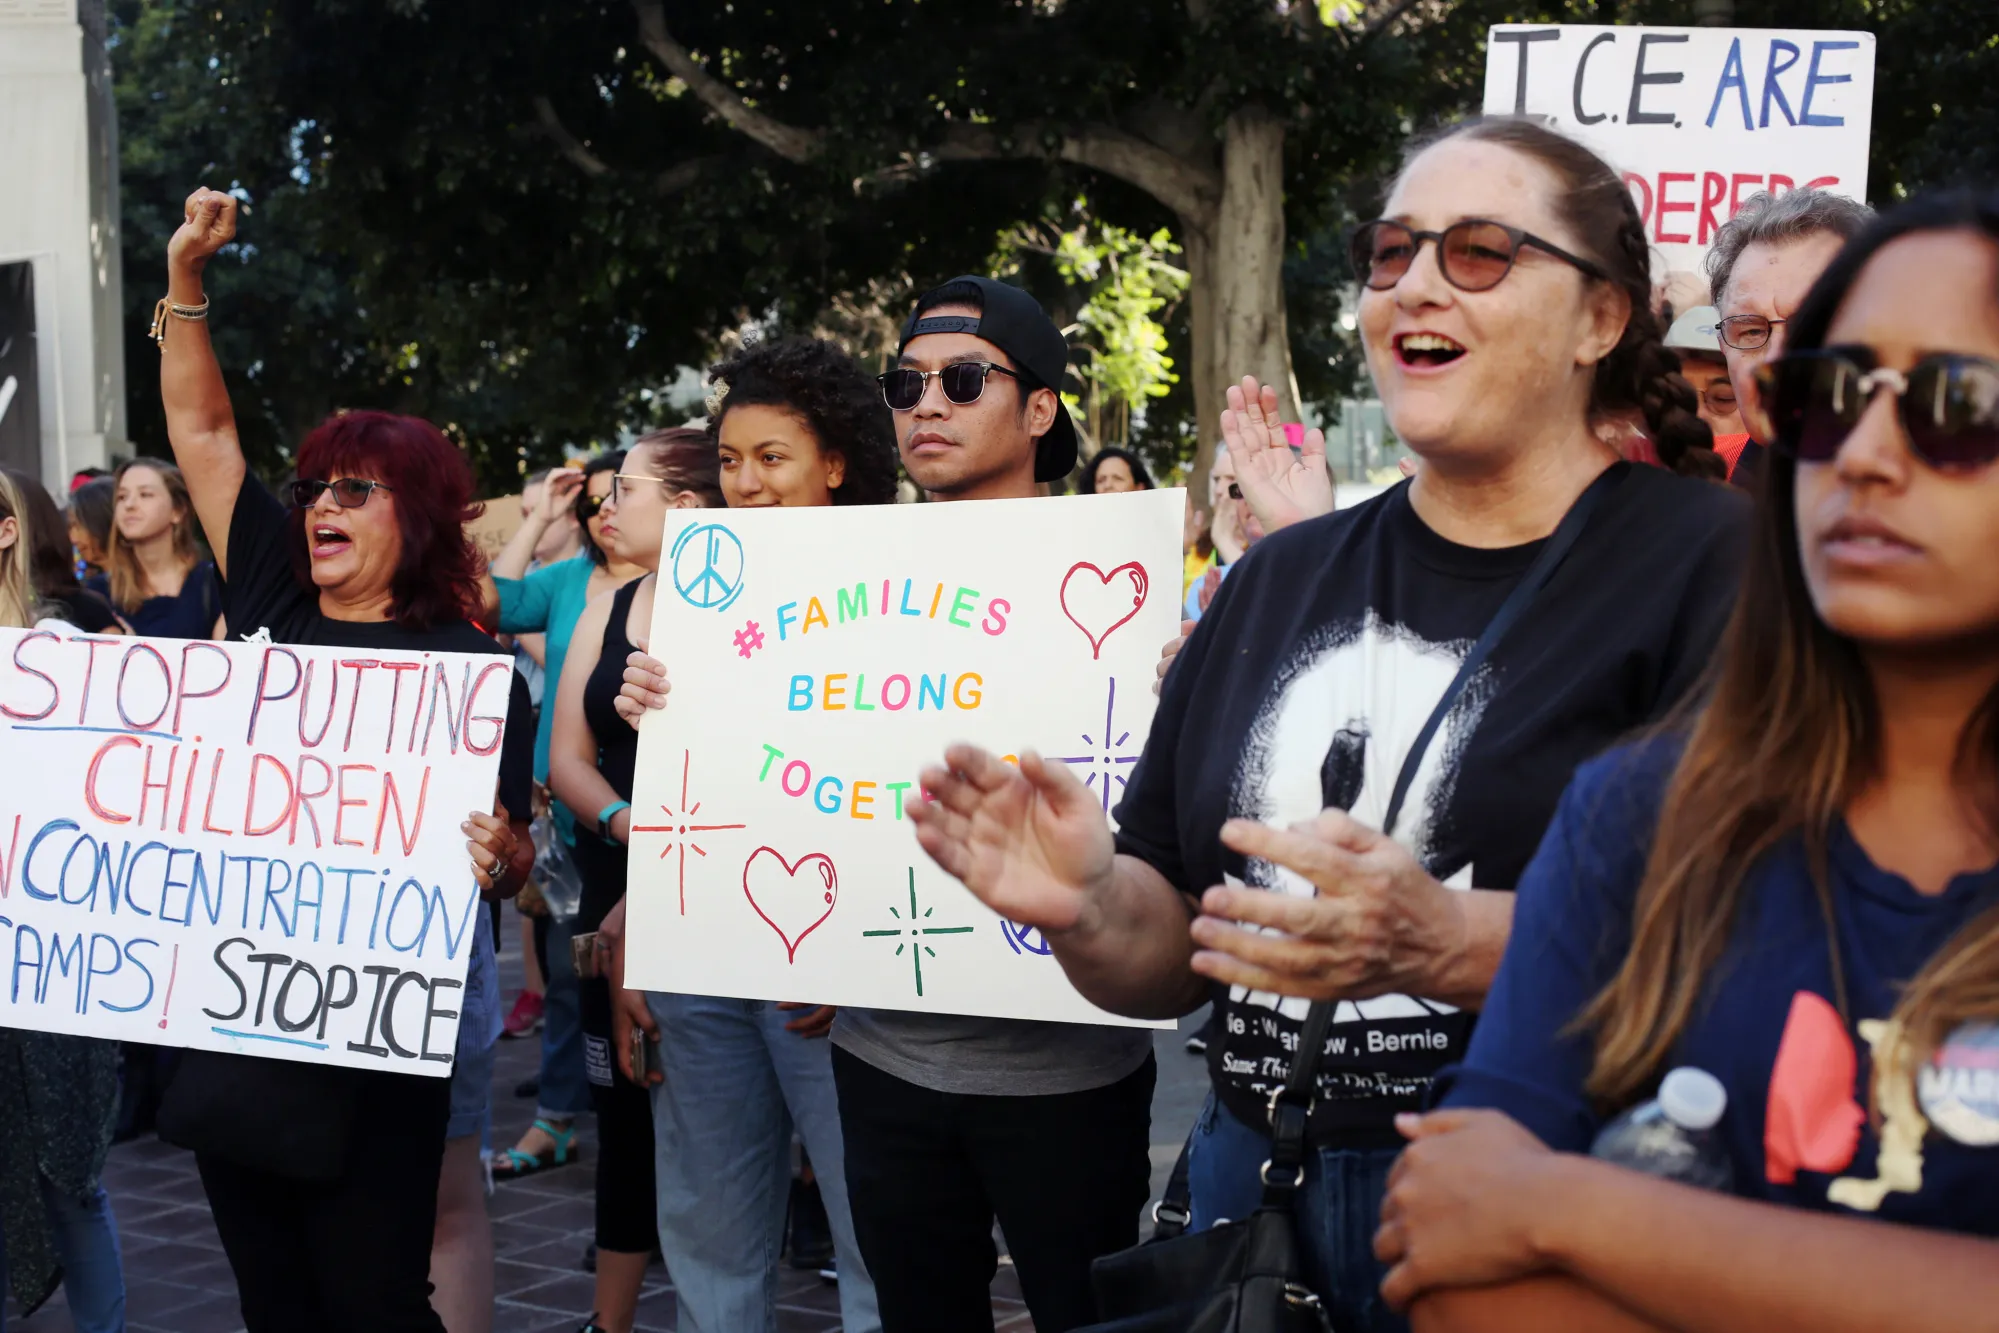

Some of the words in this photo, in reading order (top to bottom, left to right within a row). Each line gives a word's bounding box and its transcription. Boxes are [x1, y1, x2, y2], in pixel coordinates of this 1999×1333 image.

[1704, 36, 1860, 130] ARE
[733, 578, 1011, 659] #FAMILIES
[0, 629, 232, 734] STOP
[246, 646, 510, 757] PUTTiNG
[788, 672, 983, 711] BELONG
[84, 734, 431, 857] CHiLDREN
[0, 914, 179, 1029] AMPS!
[202, 937, 358, 1040] STOP
[347, 964, 463, 1062] ICE
[1366, 1028, 1448, 1053] Bernie
